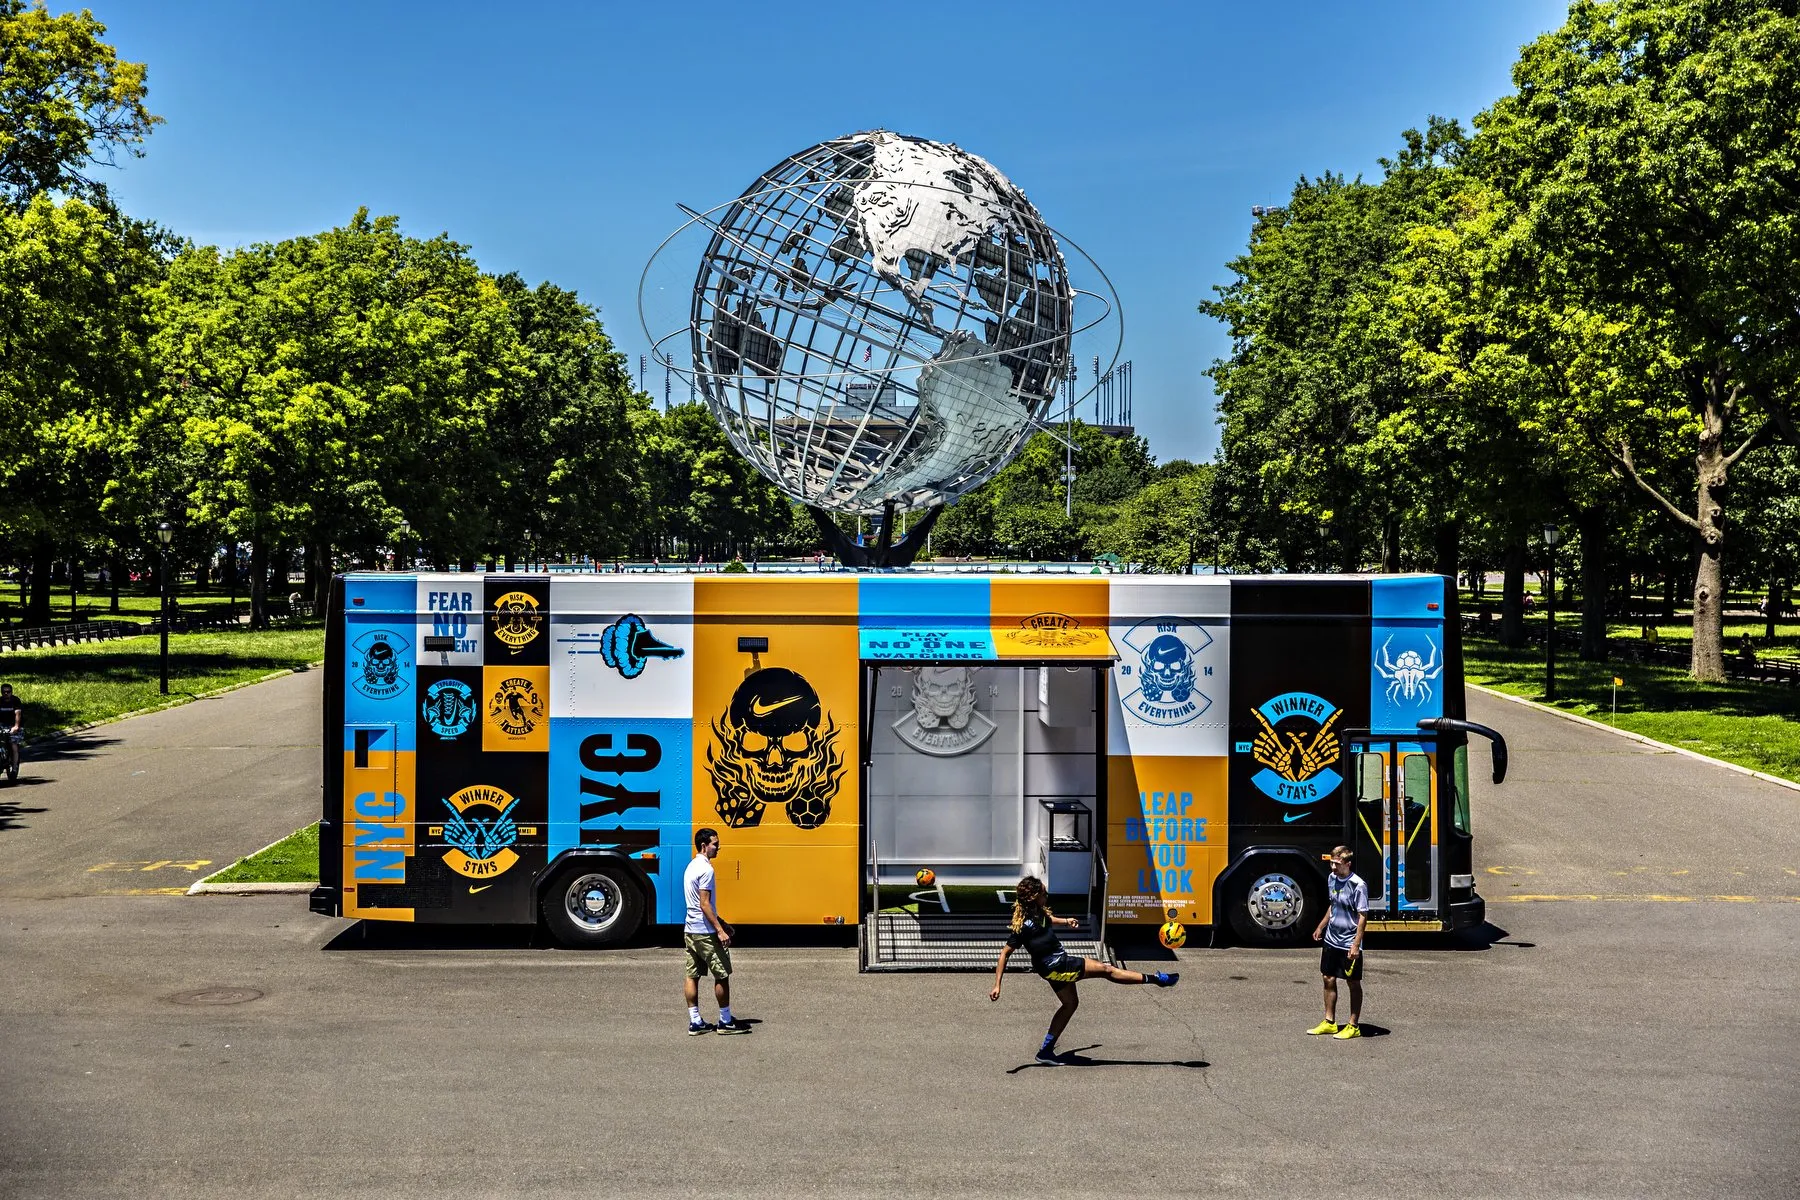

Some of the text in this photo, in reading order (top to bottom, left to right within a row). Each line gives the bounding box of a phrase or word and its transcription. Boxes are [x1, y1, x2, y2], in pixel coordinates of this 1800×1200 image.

[428, 592, 472, 611] FEAR
[509, 594, 524, 602] RISK
[433, 612, 467, 639] NO
[1030, 616, 1070, 630] CREATE
[1157, 622, 1178, 633] RISK
[497, 628, 536, 643] EVERYTHING
[923, 641, 986, 649] ONE
[1121, 666, 1131, 675] 20
[1203, 666, 1213, 676] 14
[362, 683, 400, 695] EVERYTHING
[505, 679, 528, 688] CREATE
[531, 693, 538, 704] 8
[989, 686, 999, 697] 14
[1138, 701, 1196, 719] EVERYTHING
[1271, 697, 1325, 717] WINNER
[440, 727, 458, 735] SPEED
[507, 727, 529, 735] ATTACK
[912, 726, 977, 747] EVERYTHING
[459, 788, 504, 806] WINNER
[1276, 782, 1318, 800] STAYS
[1140, 791, 1193, 816] LEAP
[354, 791, 406, 881] NYC
[1126, 817, 1208, 842] BEFORE
[1145, 843, 1187, 867] YOU
[463, 860, 498, 875] STAYS
[1138, 869, 1194, 893] LOOK
